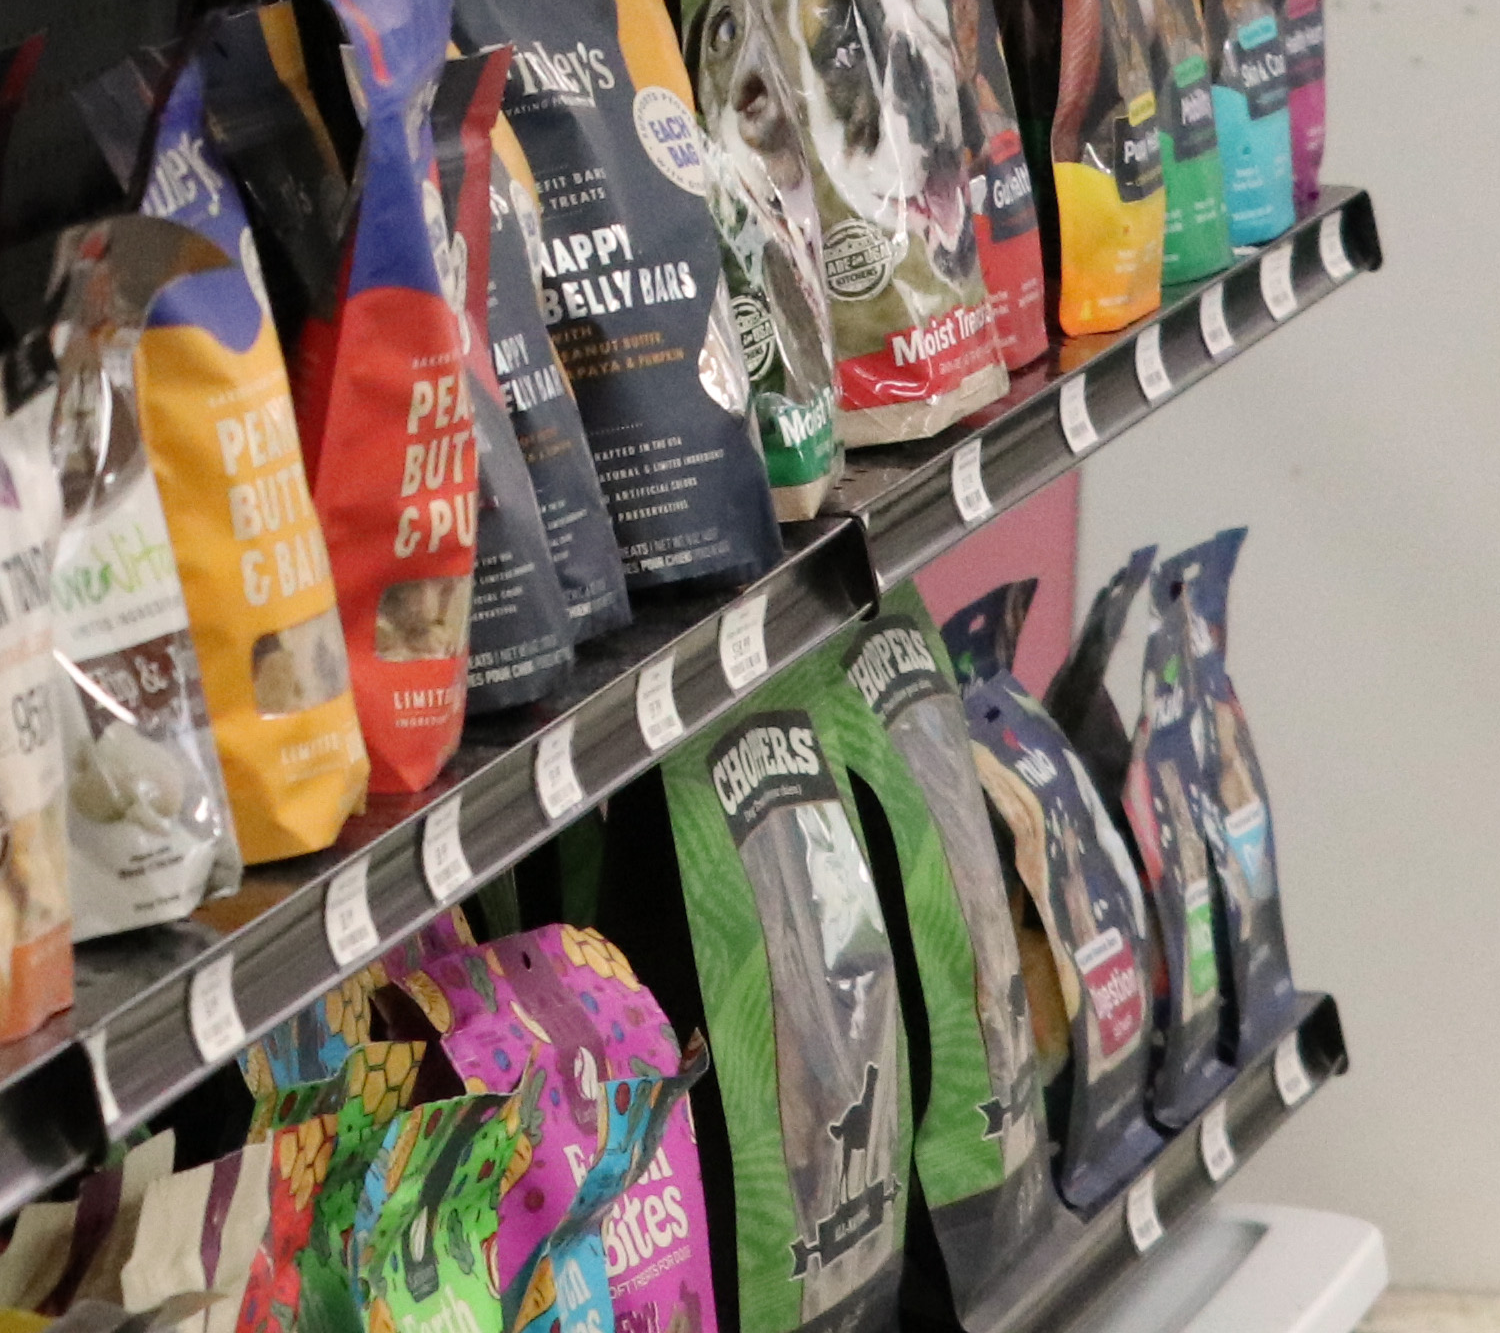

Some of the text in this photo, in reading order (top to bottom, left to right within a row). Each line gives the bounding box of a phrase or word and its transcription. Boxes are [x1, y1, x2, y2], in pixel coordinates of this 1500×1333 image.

[510, 41, 616, 108] inley's
[649, 116, 692, 143] EACH
[668, 144, 701, 169] BAG
[550, 186, 607, 210] TREATS
[543, 261, 698, 325] BELLY BARS
[891, 317, 956, 367] Moist
[407, 373, 475, 435] PEA
[604, 1186, 689, 1278] Bites
